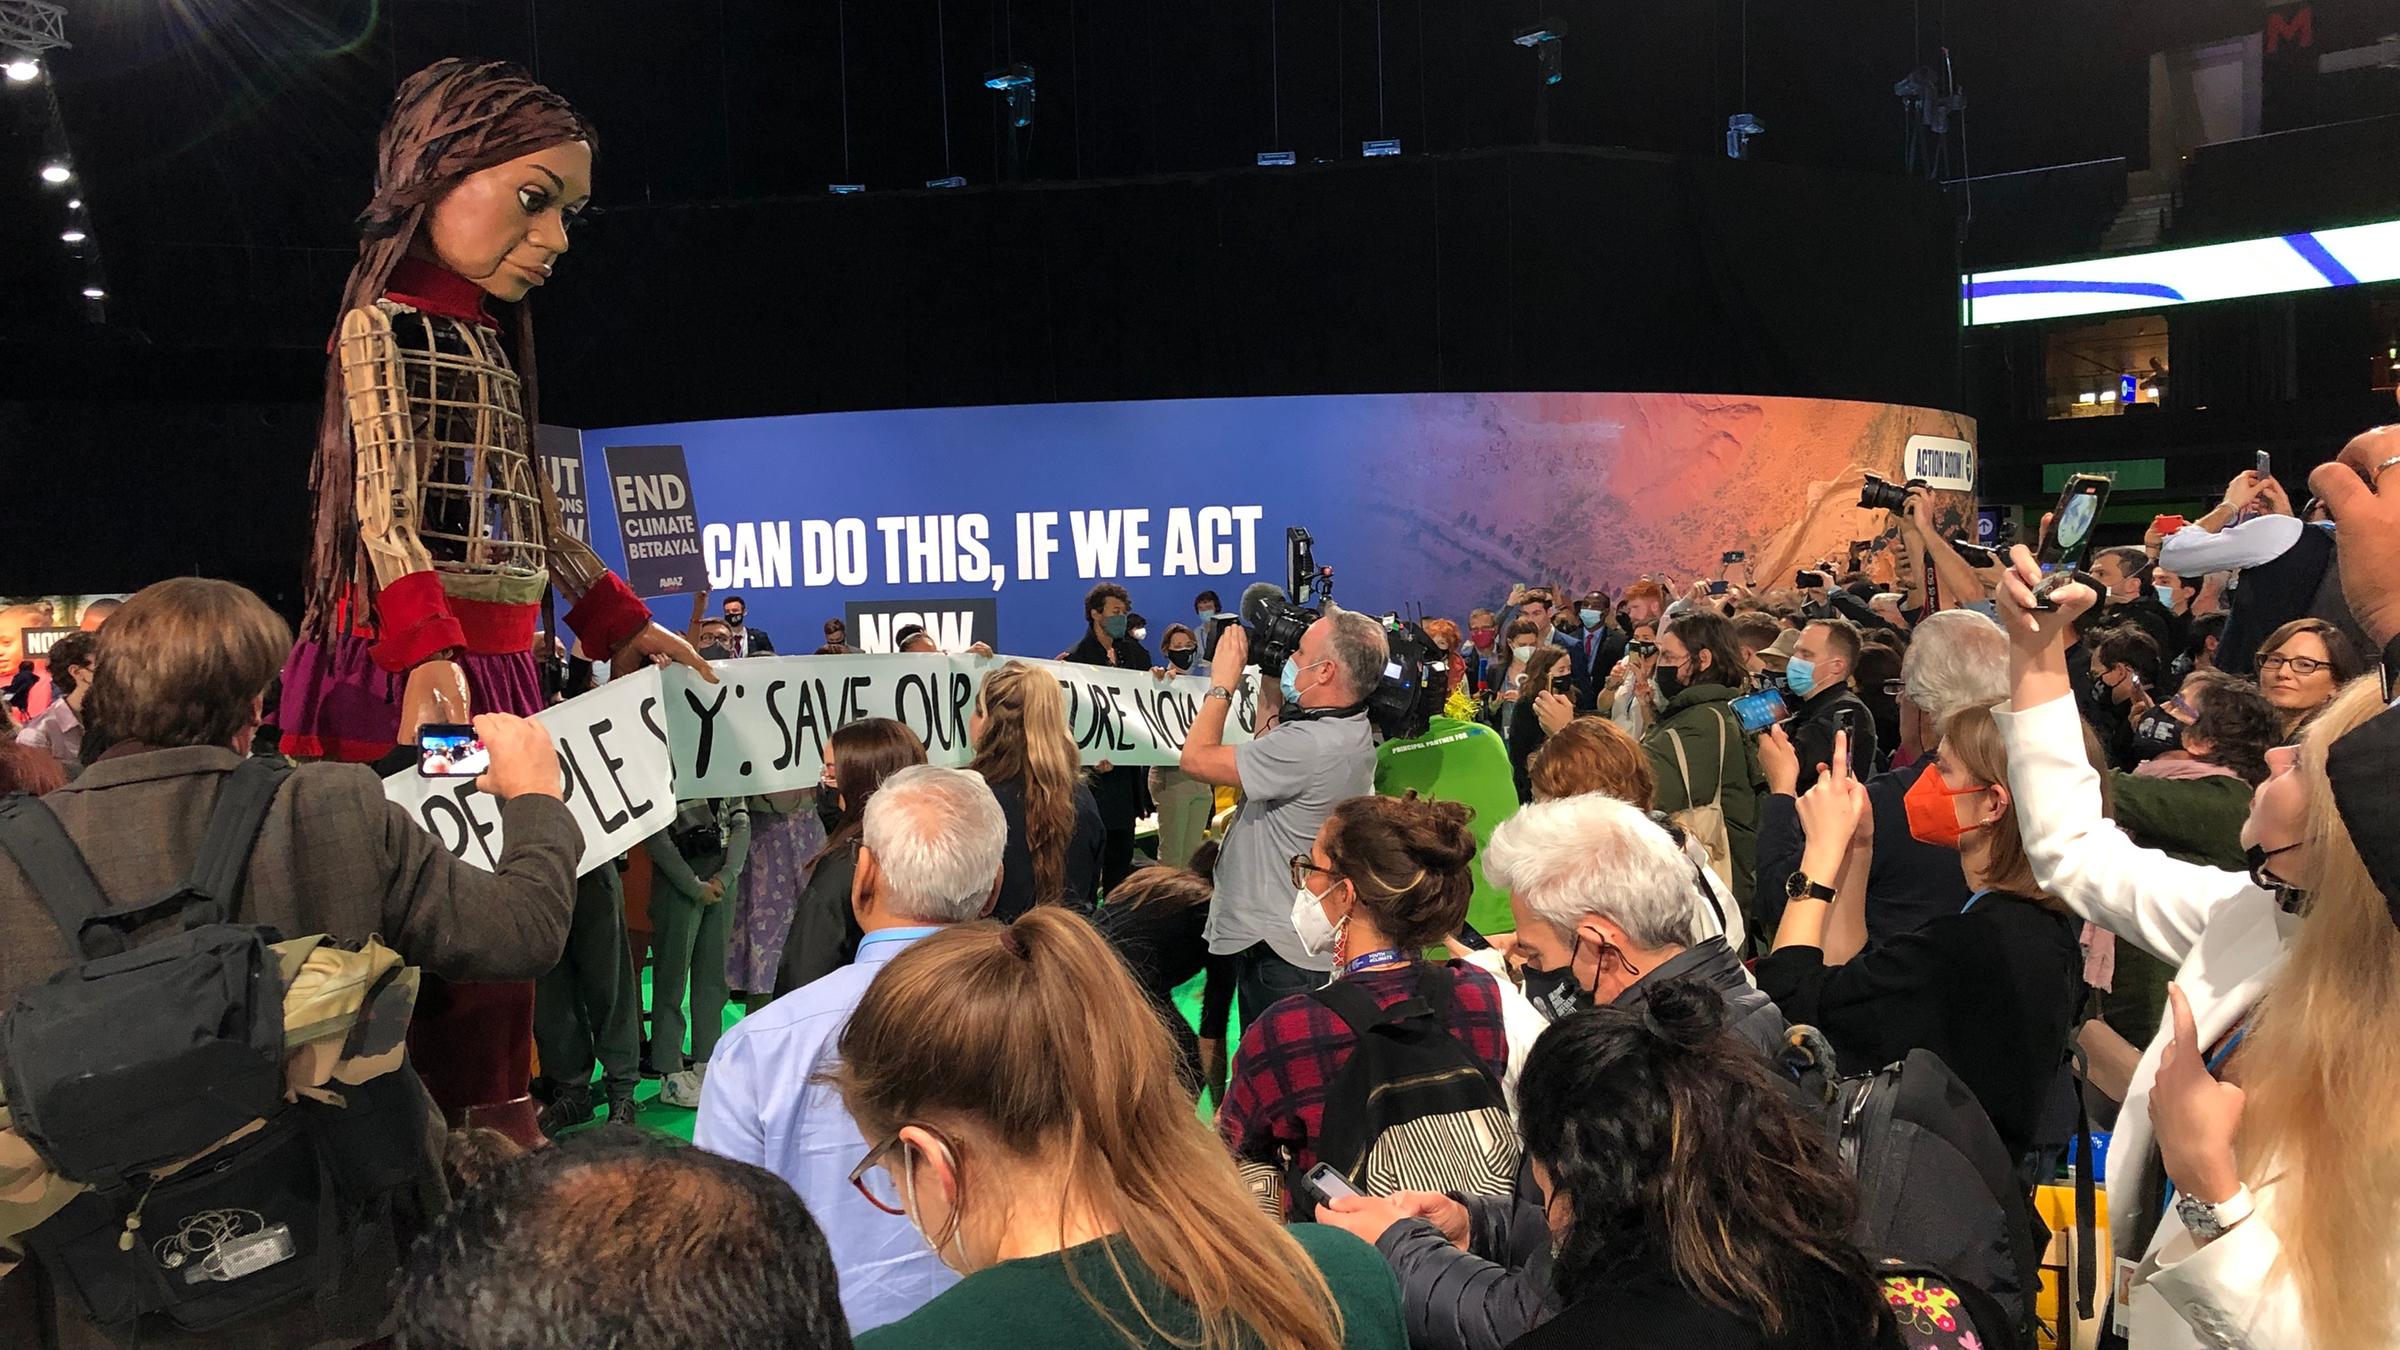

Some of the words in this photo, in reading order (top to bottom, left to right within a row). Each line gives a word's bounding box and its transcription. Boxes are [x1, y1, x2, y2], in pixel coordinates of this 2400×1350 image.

[1916, 448, 1944, 477] ACTION
[616, 474, 686, 512] END
[625, 515, 695, 537] CLIMATE
[629, 538, 699, 559] BETRAYAL
[703, 520, 793, 590] CAN
[801, 518, 868, 587] DO
[877, 513, 1005, 592] THIS,
[1016, 511, 1058, 580] IF
[1070, 508, 1150, 579] WE
[1163, 505, 1262, 577] ACT
[27, 631, 73, 654] NO
[766, 675, 871, 771] SAVE
[895, 672, 972, 751] OUR
[1392, 743, 1425, 754] PRINCIPAL
[1426, 736, 1455, 747] PARTNER
[1455, 732, 1469, 741] FOR
